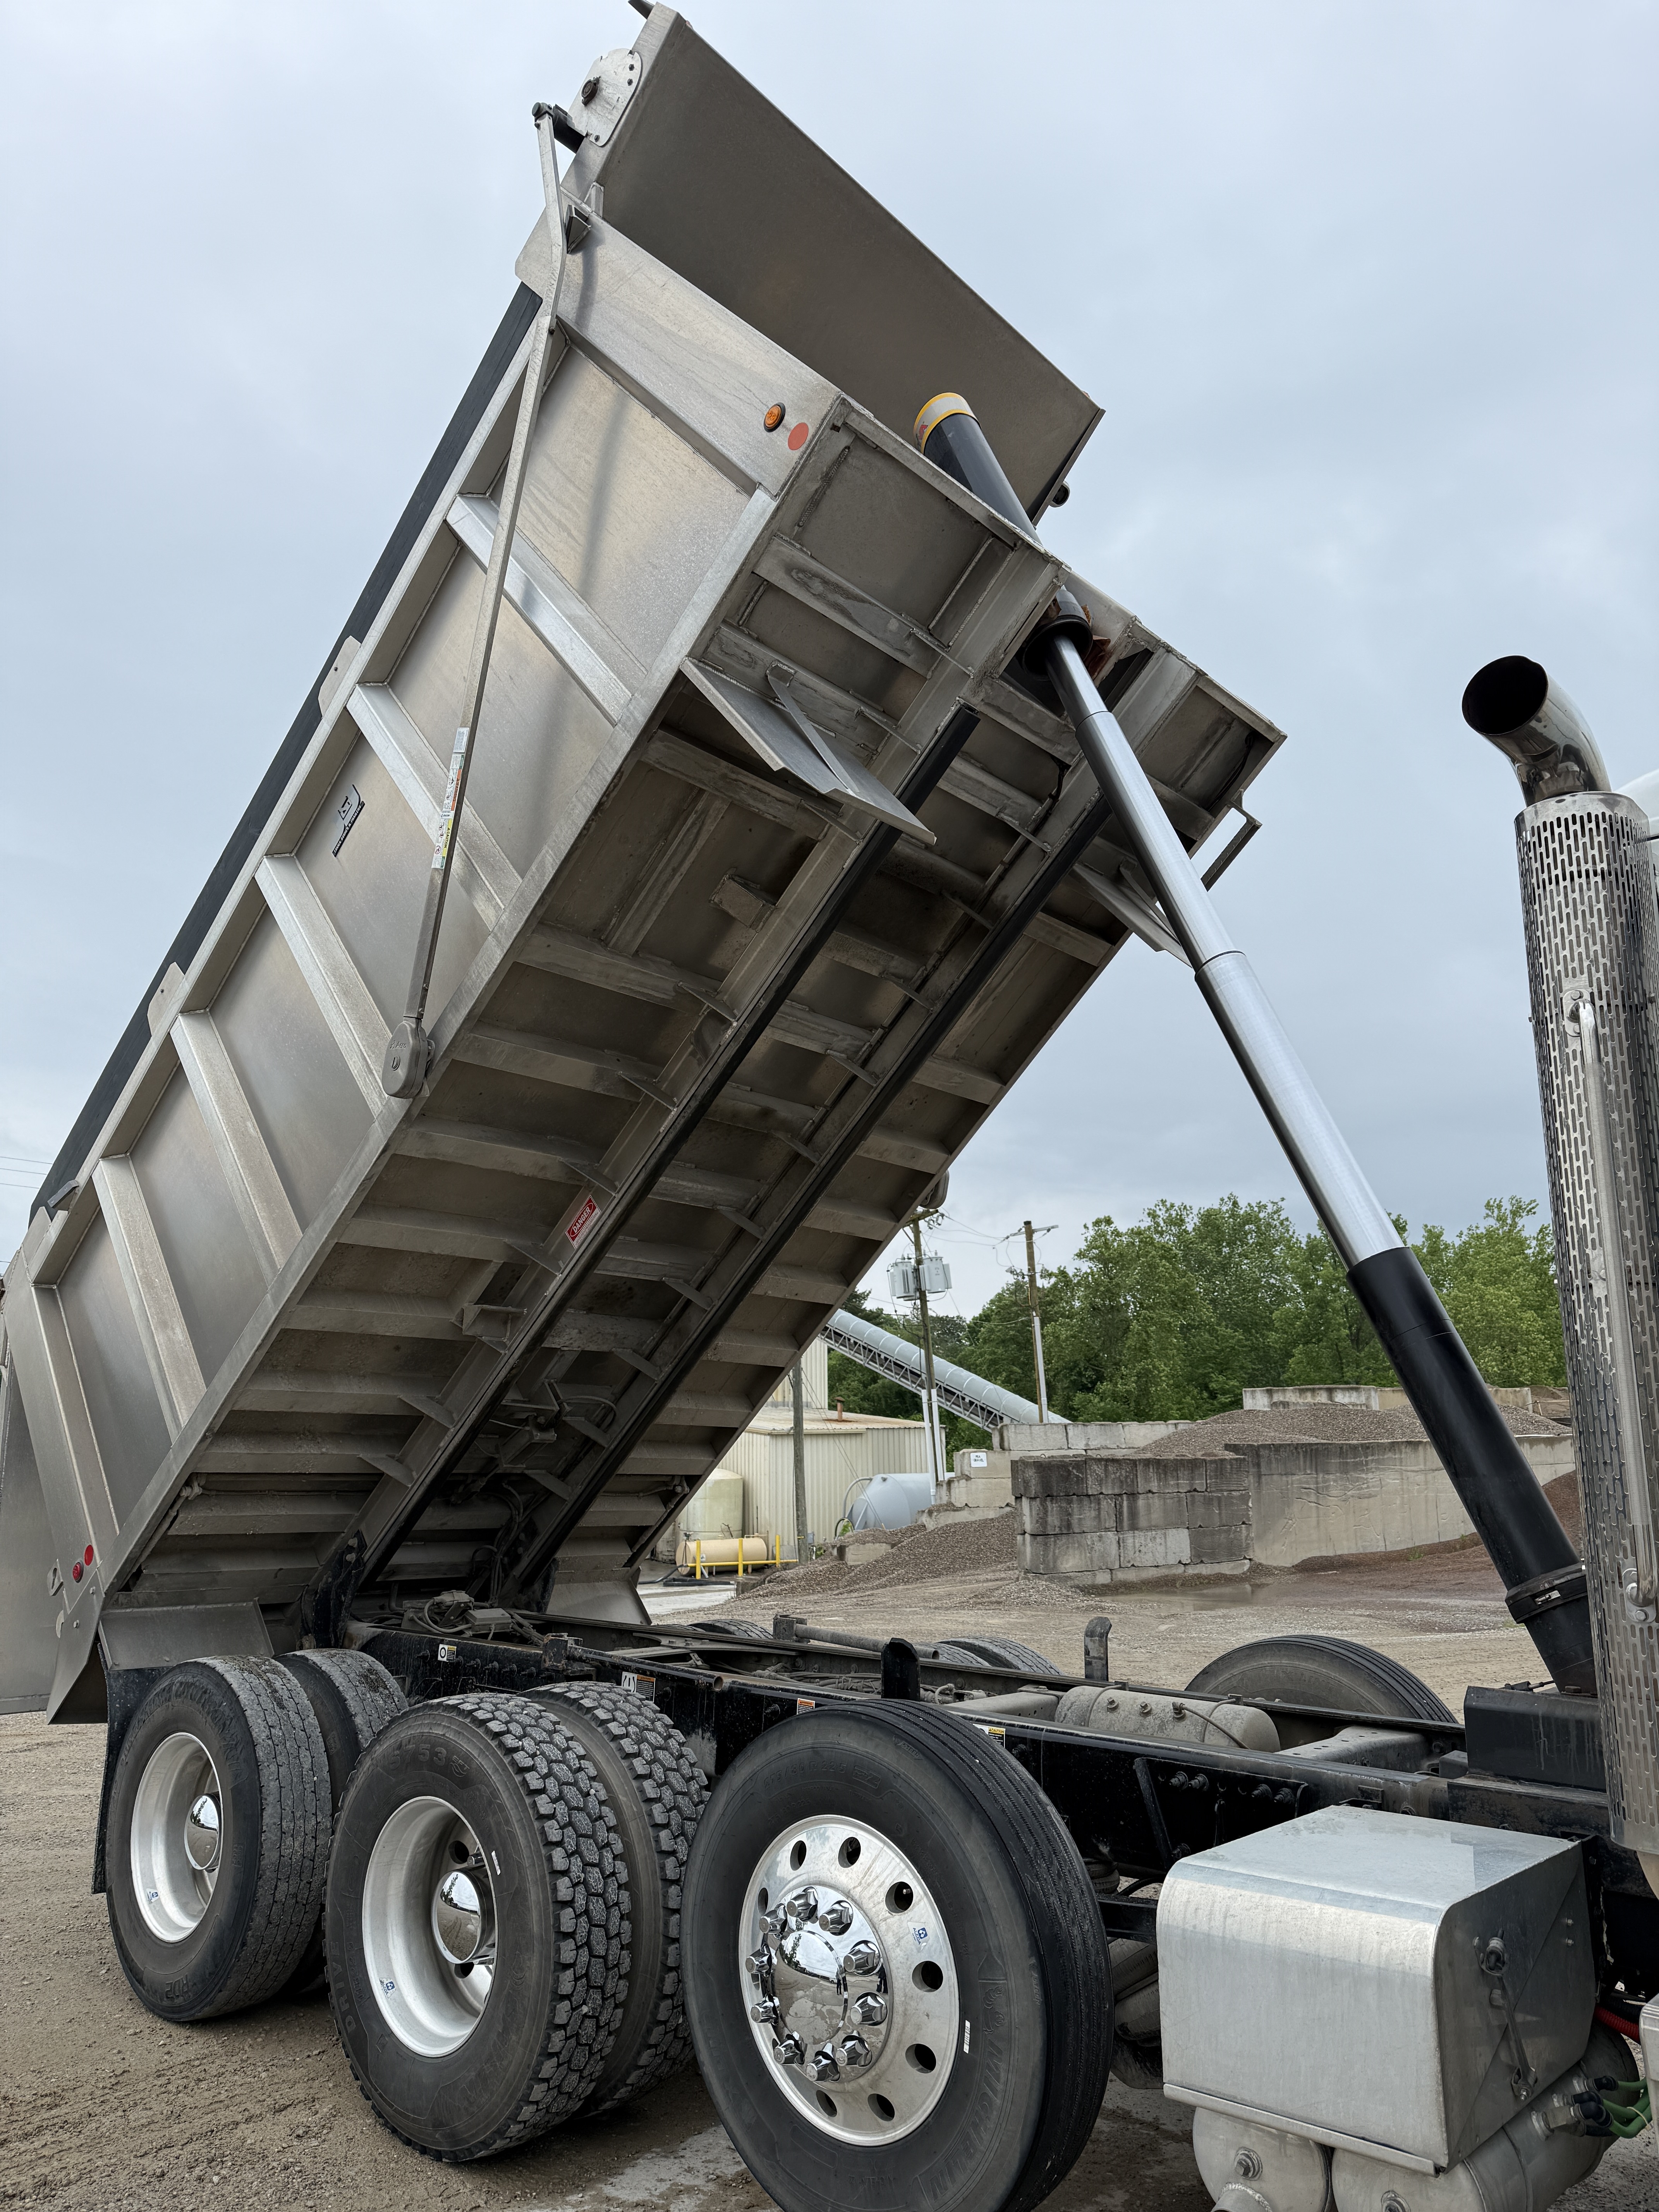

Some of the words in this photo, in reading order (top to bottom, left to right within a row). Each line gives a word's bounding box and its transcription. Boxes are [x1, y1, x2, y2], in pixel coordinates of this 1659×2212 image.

[573, 1206, 591, 1233] DANGER
[913, 1928, 921, 1945] ALCOA
[330, 1942, 356, 2032] DRIVE
